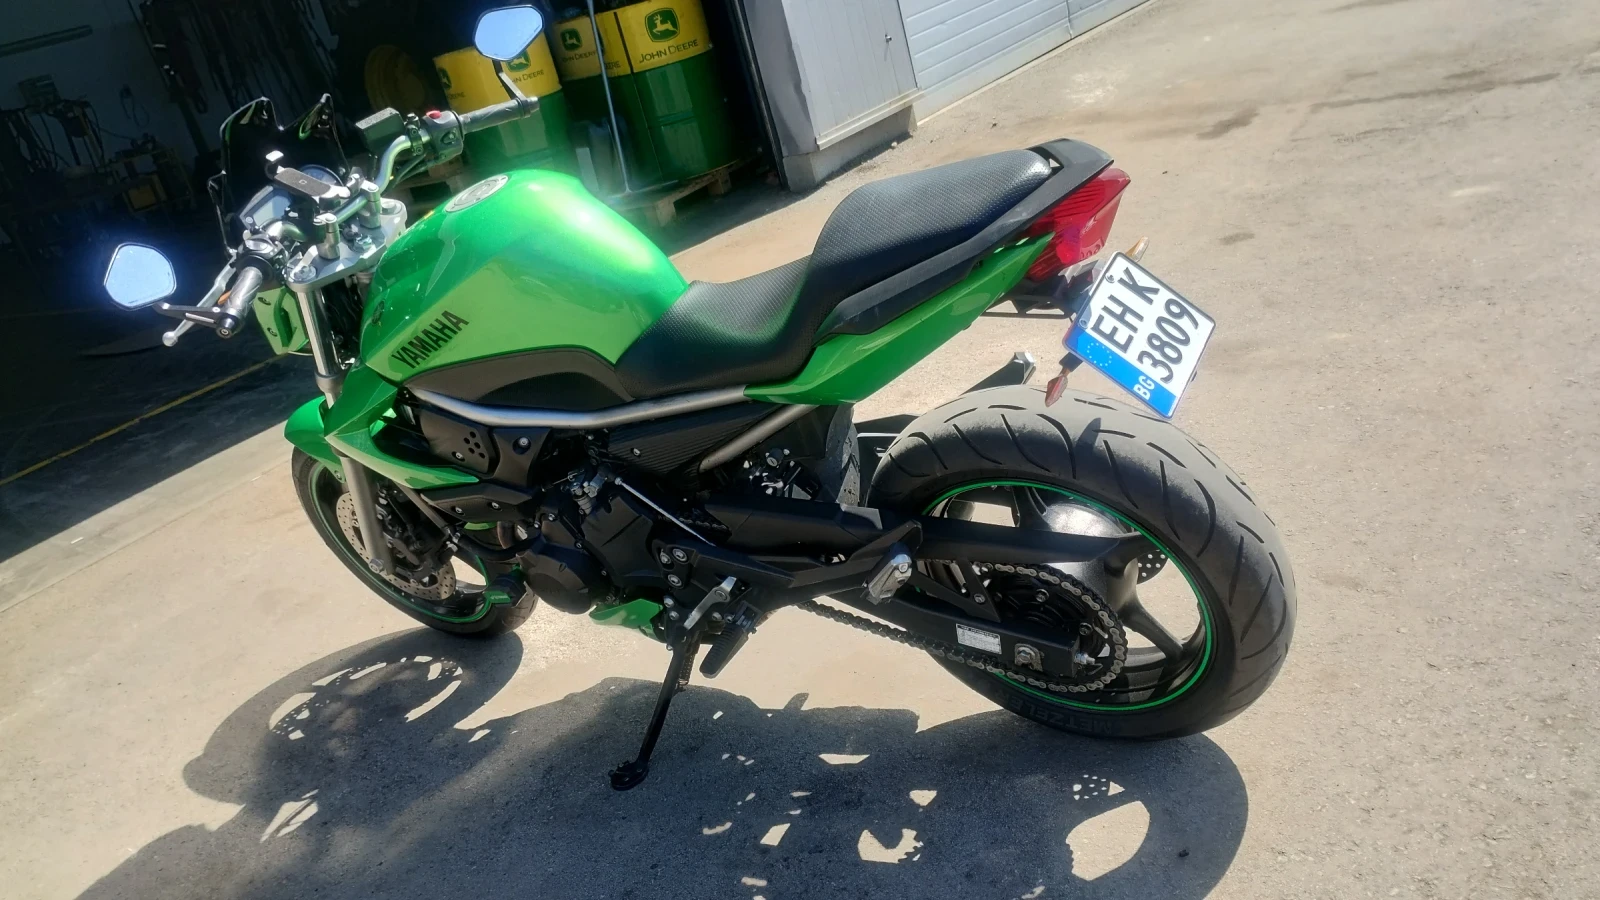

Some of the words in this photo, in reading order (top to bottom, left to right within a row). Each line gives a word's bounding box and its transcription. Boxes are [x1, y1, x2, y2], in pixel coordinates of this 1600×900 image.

[639, 48, 667, 63] JOHN
[668, 40, 699, 55] DEERE
[522, 69, 544, 81] DEERE
[391, 310, 469, 369] YAMAHA
[1137, 298, 1198, 383] 3809
[1133, 375, 1155, 400] BG
[995, 690, 1112, 734] METZELER
